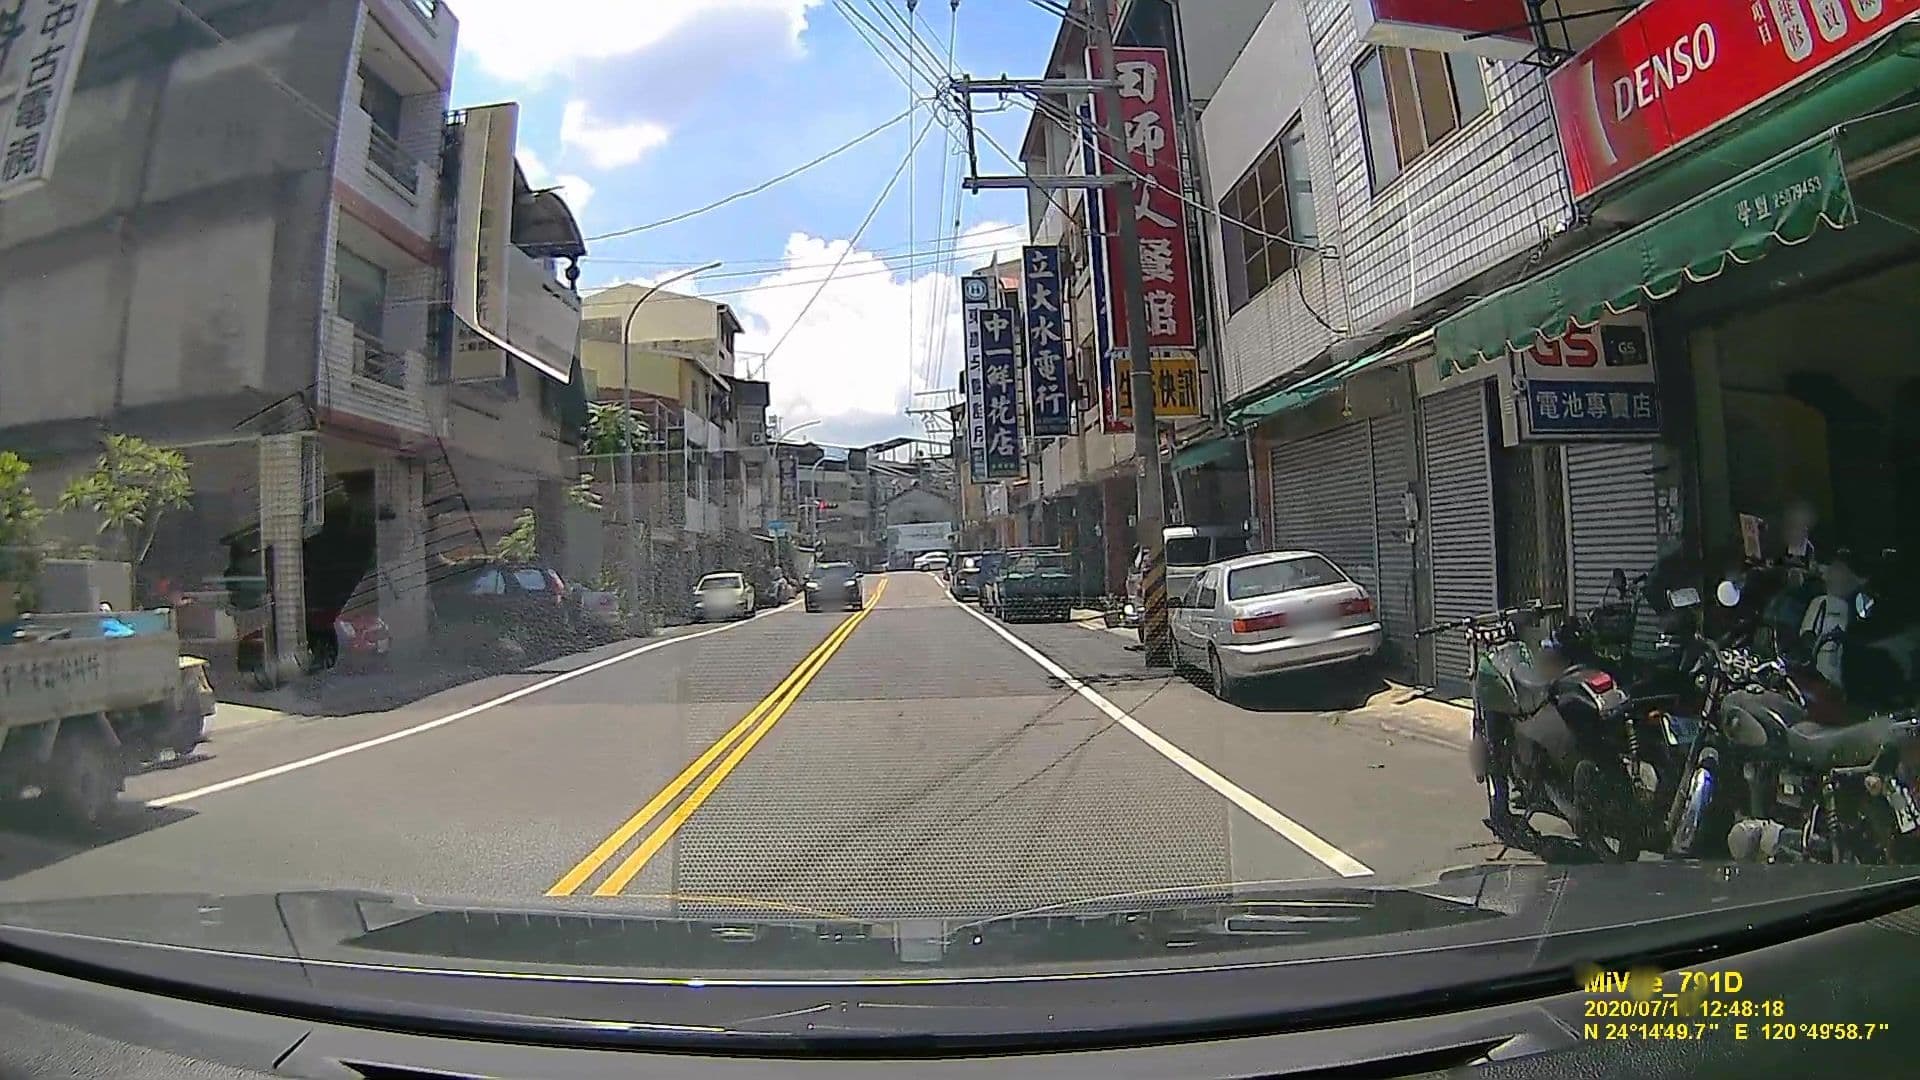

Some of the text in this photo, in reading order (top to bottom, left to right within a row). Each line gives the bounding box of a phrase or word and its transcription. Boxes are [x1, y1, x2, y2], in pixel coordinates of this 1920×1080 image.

[1613, 22, 1716, 121] DENSO
[984, 312, 1015, 456] 中一鮮花店
[1028, 250, 1064, 415] 立大水電行
